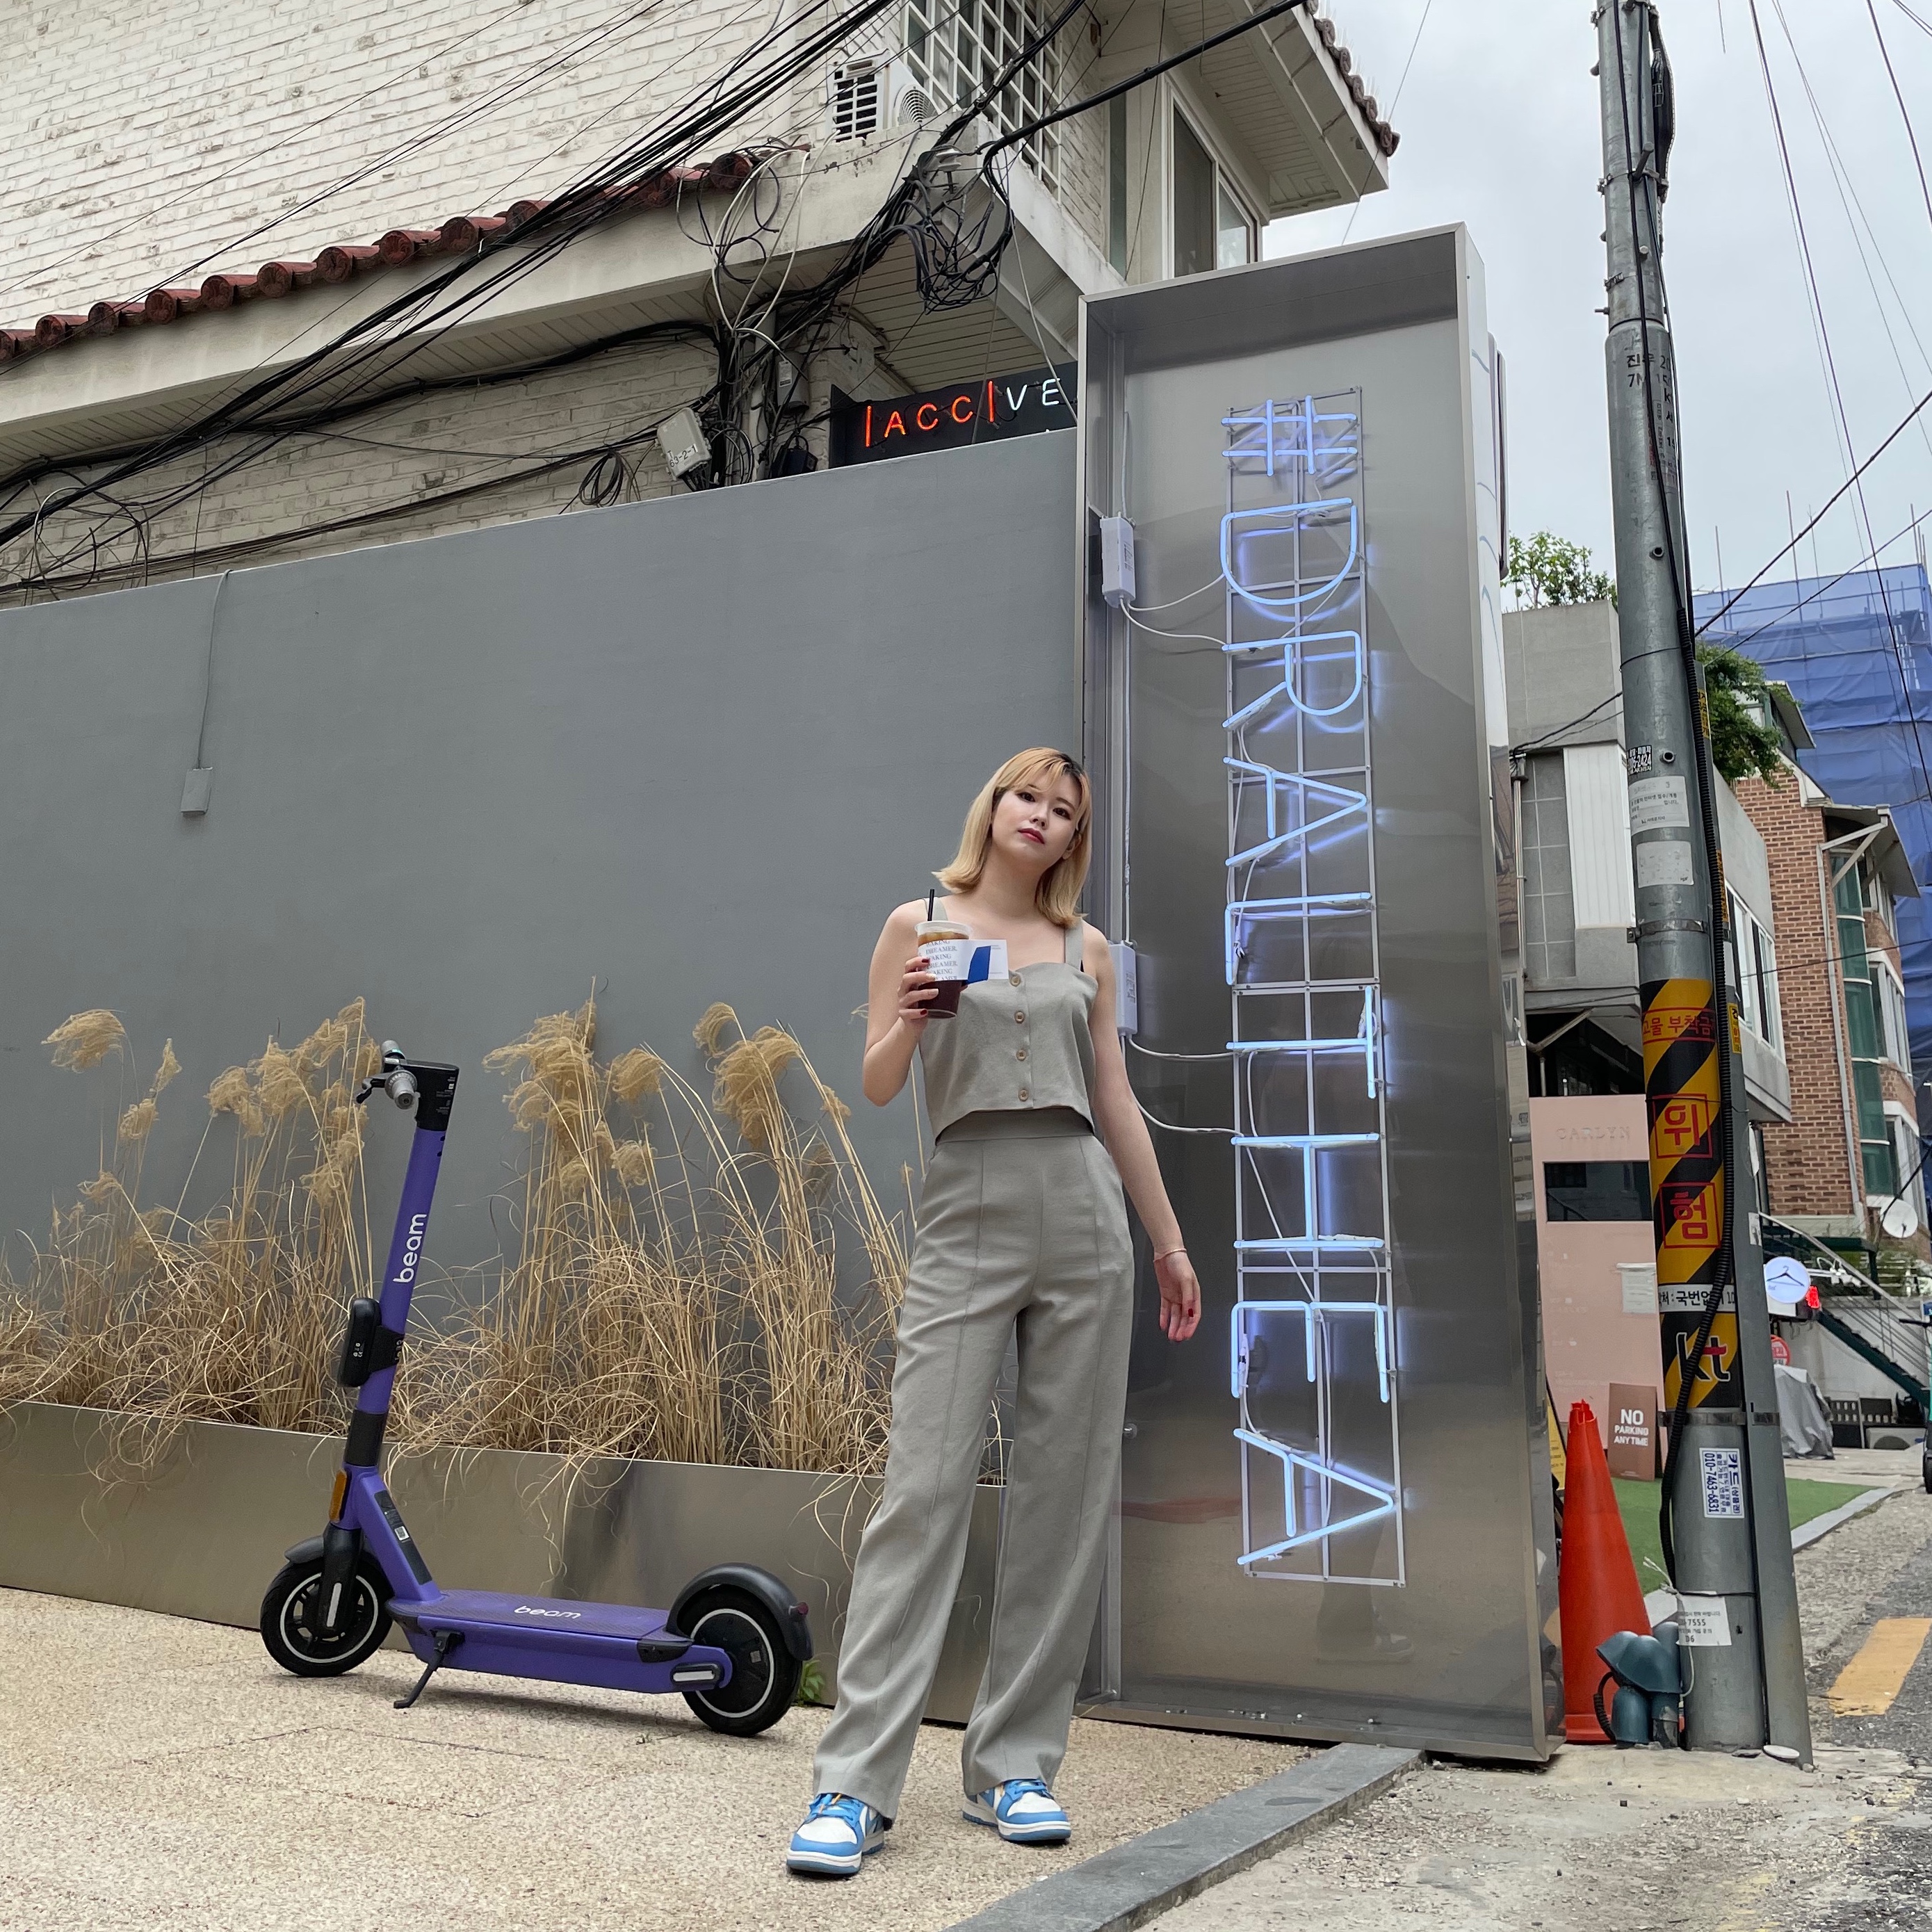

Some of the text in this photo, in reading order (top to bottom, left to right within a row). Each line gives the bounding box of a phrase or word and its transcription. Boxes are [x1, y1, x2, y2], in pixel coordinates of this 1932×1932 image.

[669, 445, 697, 467] 63-2-1
[392, 1212, 428, 1283] beam
[1676, 1332, 1730, 1382] kt
[1621, 1409, 1644, 1425] NO
[1704, 1452, 1719, 1513] 010-7463-6831
[513, 1605, 581, 1620] beam
